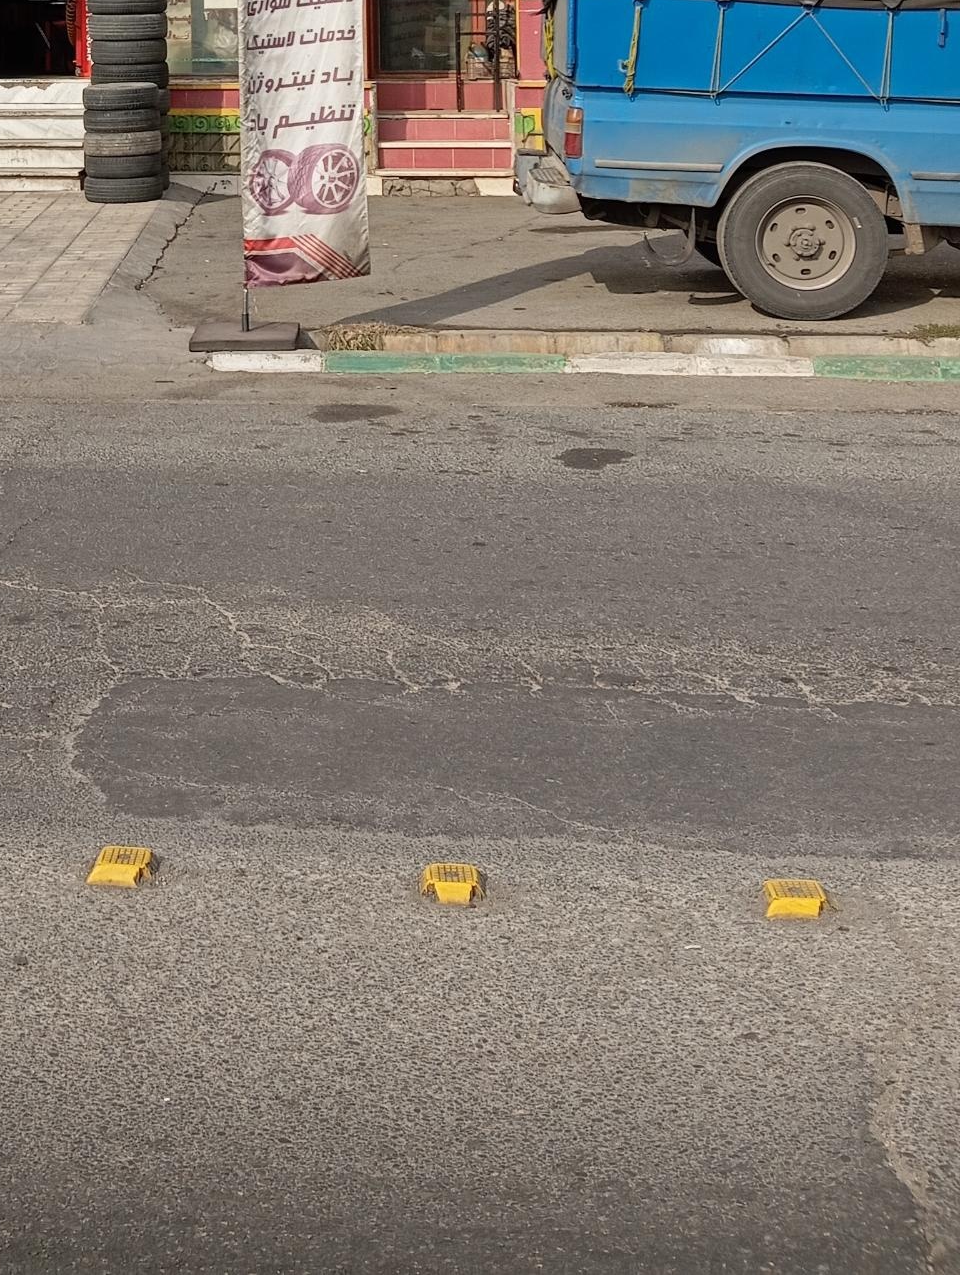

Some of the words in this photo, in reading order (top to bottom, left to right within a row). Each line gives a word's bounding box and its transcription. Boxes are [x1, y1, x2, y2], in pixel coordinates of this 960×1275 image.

[246, 31, 295, 55] لاستیک
[299, 24, 356, 46] خدمات
[248, 69, 315, 95] نیتروژن
[320, 66, 354, 86] باد
[248, 113, 268, 136] باد
[272, 103, 356, 139] تنظیم
